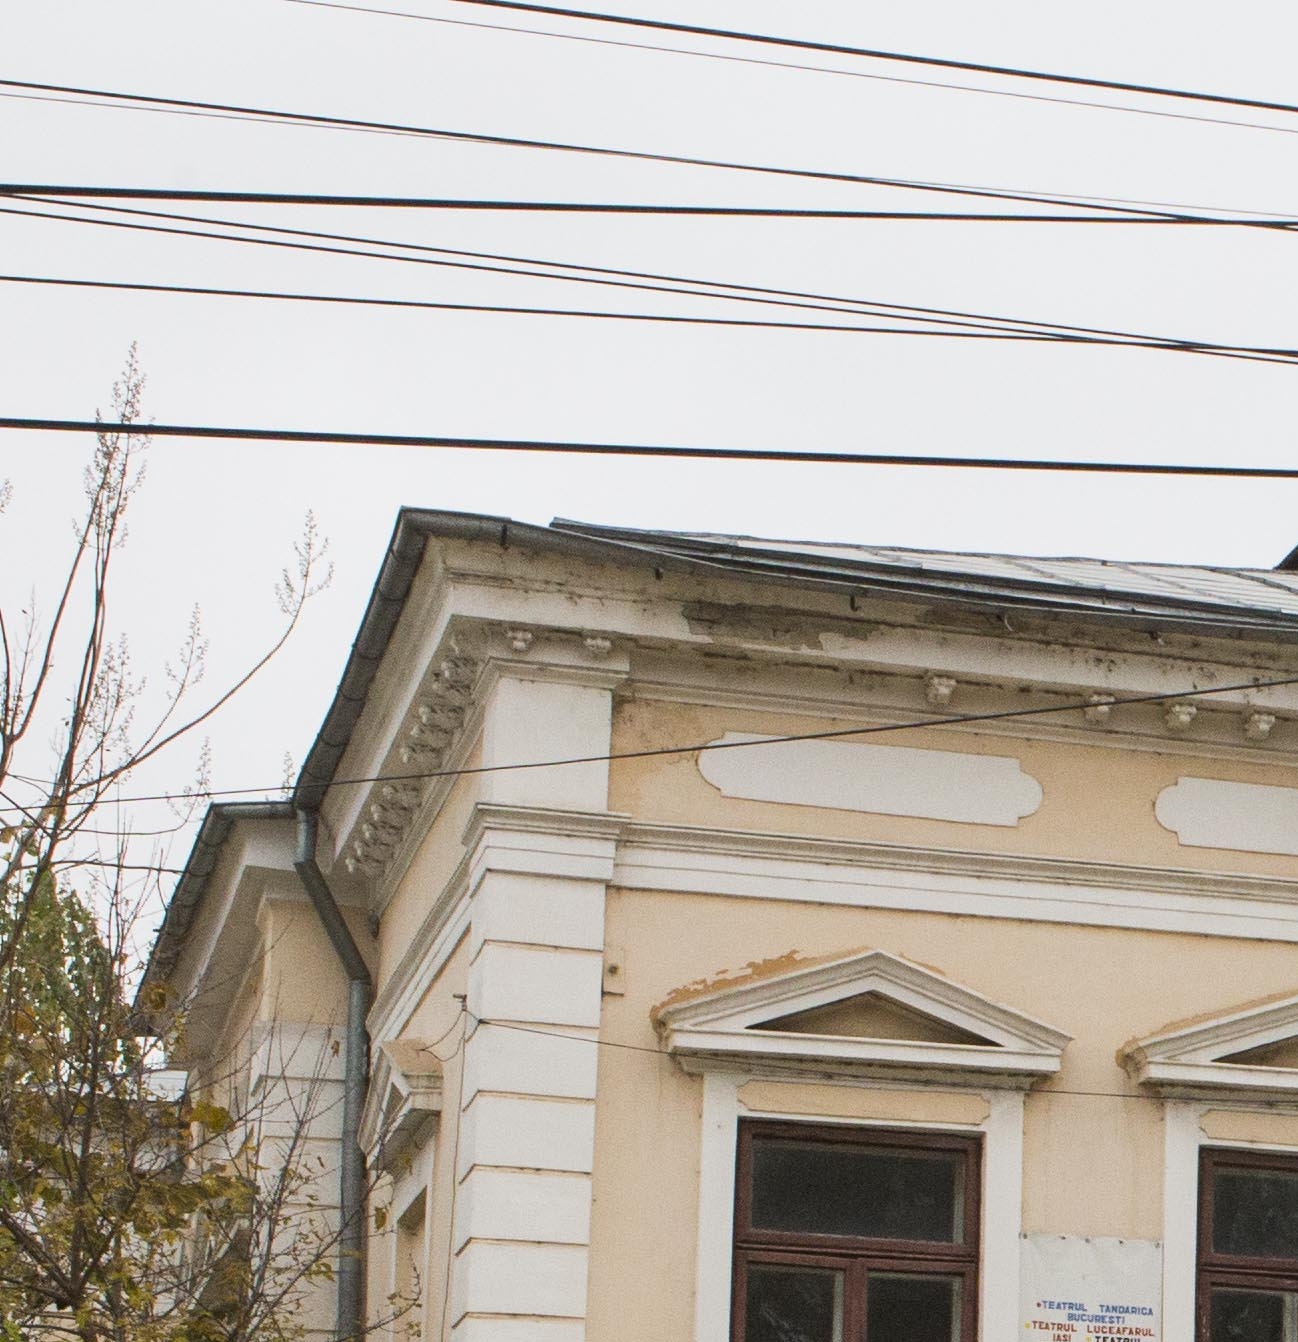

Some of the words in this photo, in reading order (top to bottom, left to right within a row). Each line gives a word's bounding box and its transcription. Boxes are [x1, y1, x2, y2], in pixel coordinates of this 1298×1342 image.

[1041, 1300, 1087, 1312] TEATRUL
[1099, 1304, 1154, 1316] TANDARICA
[1067, 1313, 1125, 1325] BUCURESTI
[1031, 1320, 1077, 1332] TEATRUL
[1087, 1325, 1155, 1337] LUCEAFARUL
[1053, 1333, 1071, 1342] IASI
